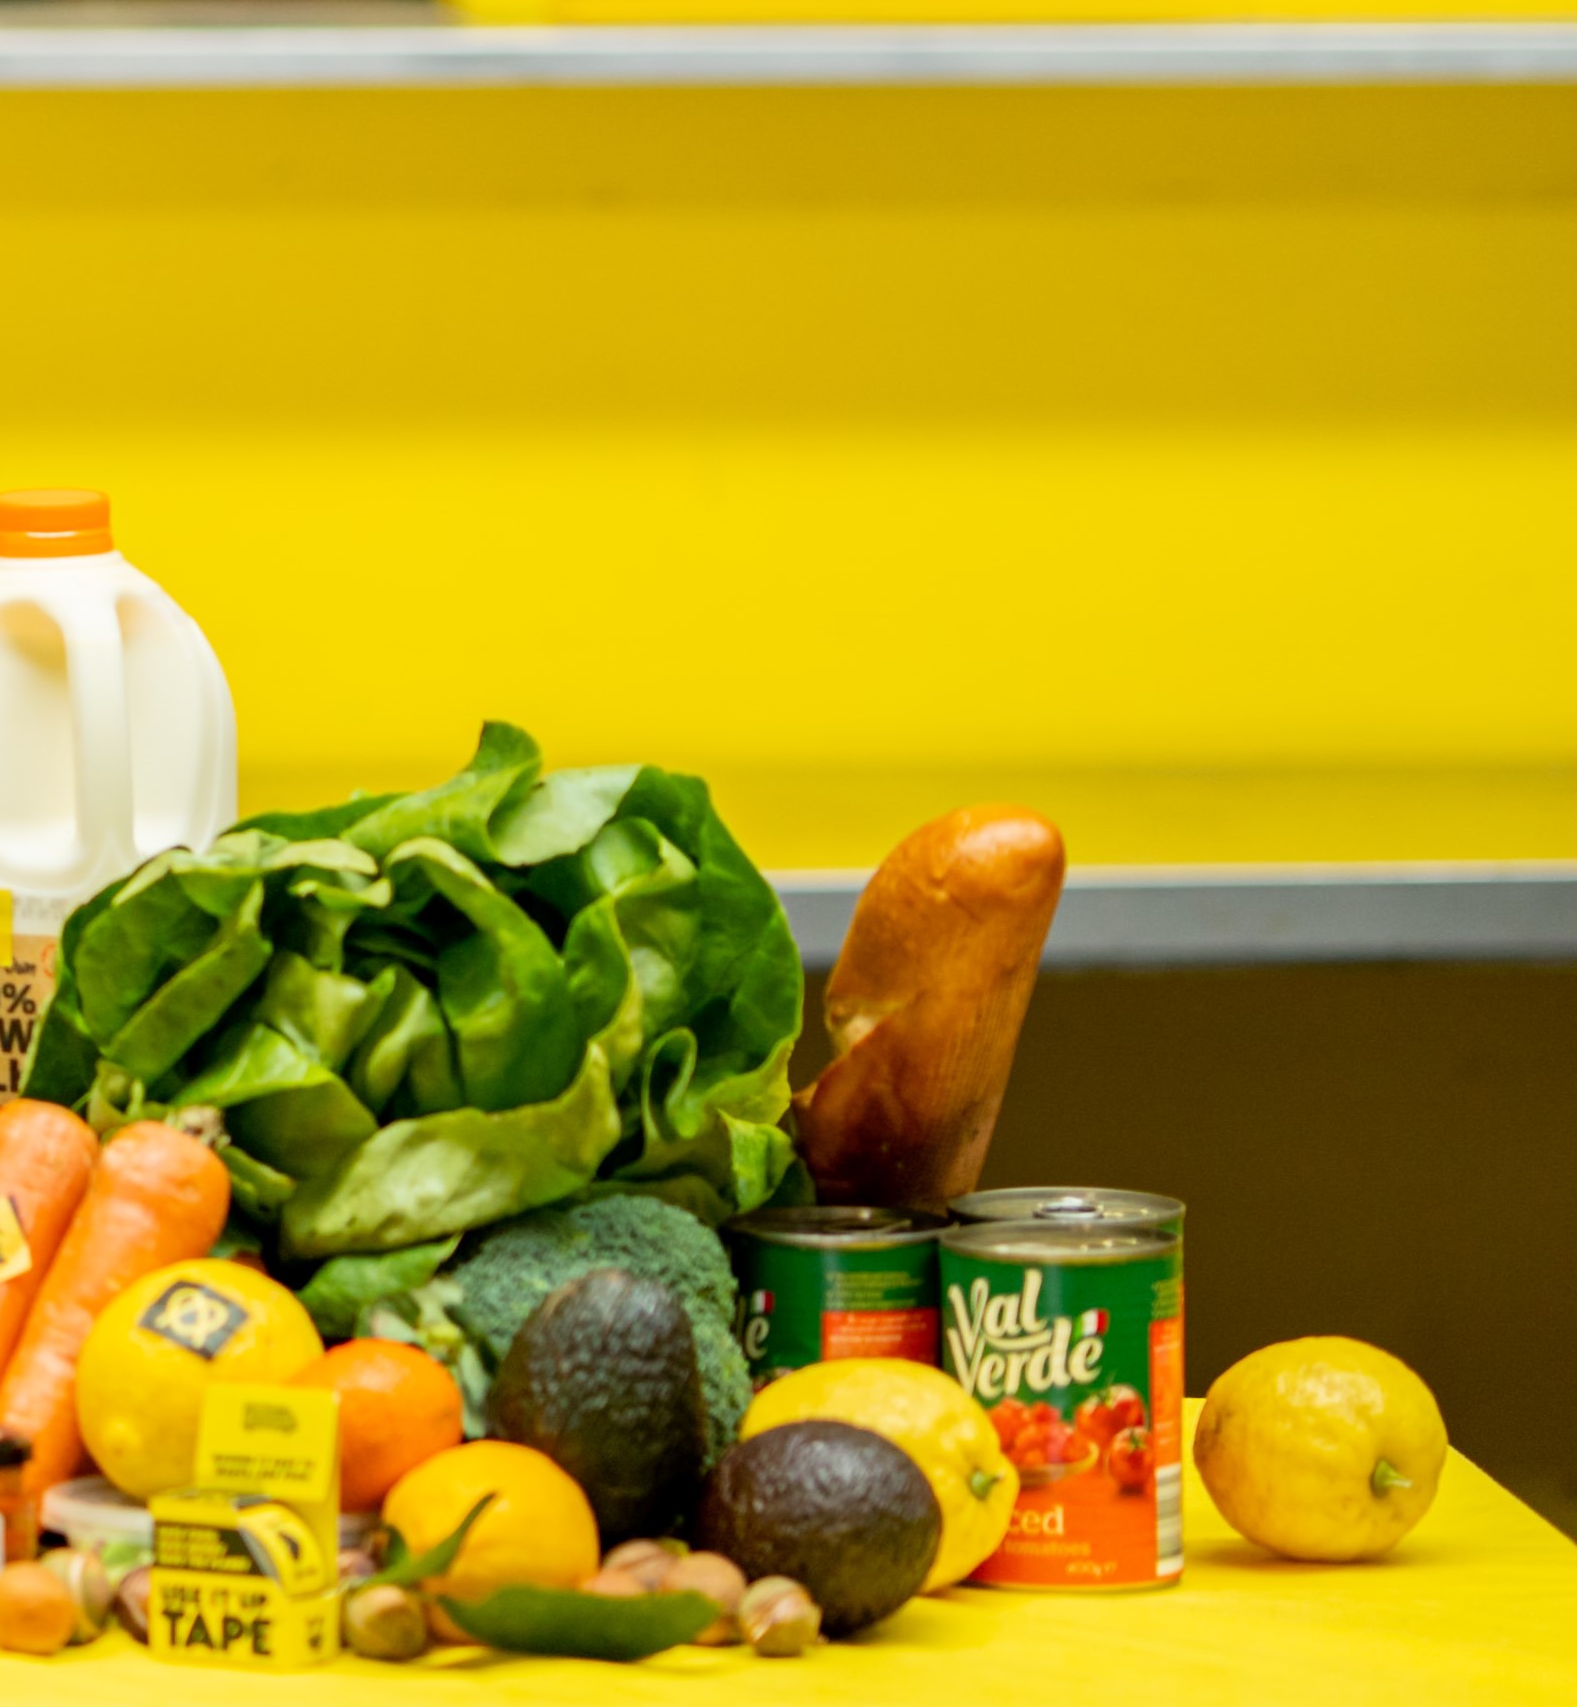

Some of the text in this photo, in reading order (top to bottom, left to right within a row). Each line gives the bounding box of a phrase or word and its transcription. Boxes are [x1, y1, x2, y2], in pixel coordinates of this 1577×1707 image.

[947, 1268, 1053, 1359] Val
[946, 1315, 1104, 1399] Verde
[1008, 1504, 1064, 1536] ced
[161, 1609, 273, 1656] TAPE
